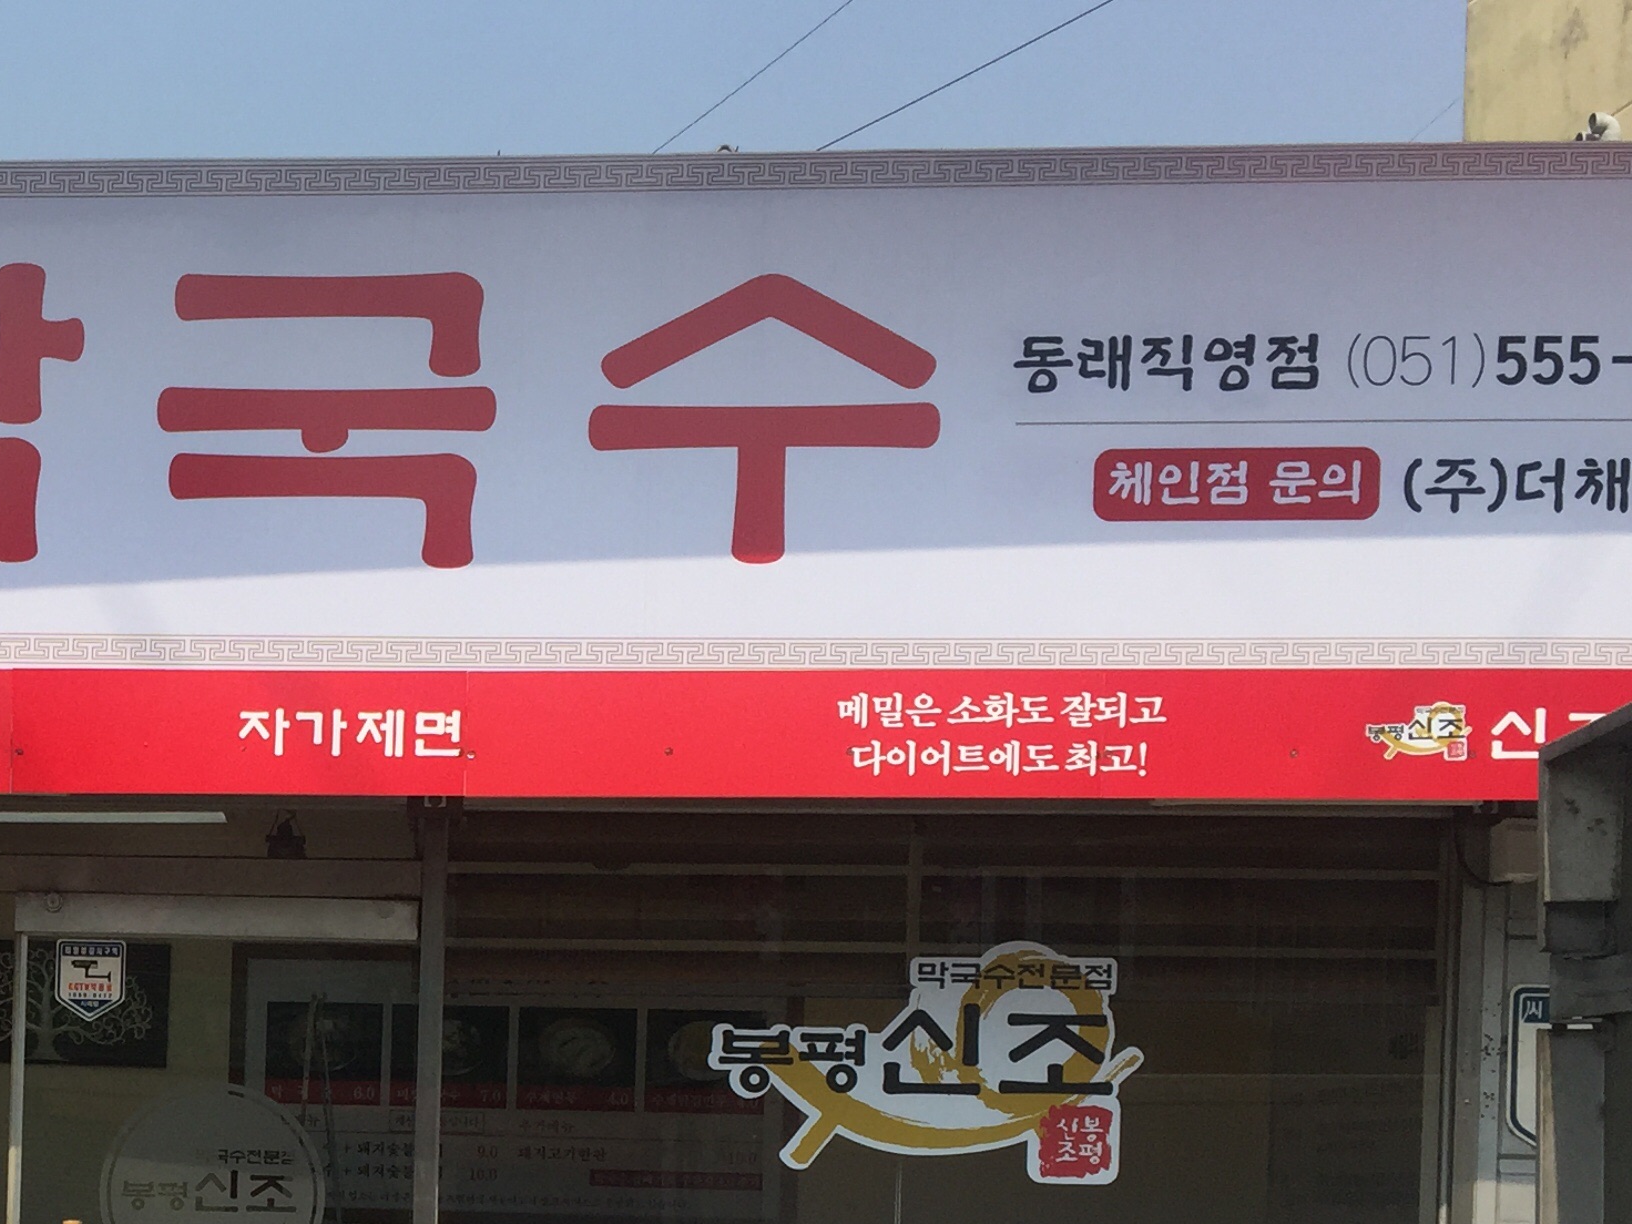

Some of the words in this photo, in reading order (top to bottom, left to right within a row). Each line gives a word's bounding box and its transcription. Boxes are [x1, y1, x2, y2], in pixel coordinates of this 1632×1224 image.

[1013, 333, 1320, 394] 동래직영점
[1108, 459, 1250, 505] 체인점
[1269, 458, 1361, 504] 문의
[837, 693, 942, 729] 메밀은
[947, 694, 1054, 728] 소화도
[1059, 693, 1168, 729] 잘되고
[238, 709, 463, 758] 자가제면
[850, 739, 1059, 776] 다이어트에도
[1064, 740, 1148, 777] 최고!
[916, 962, 1113, 992] 막국수전문점
